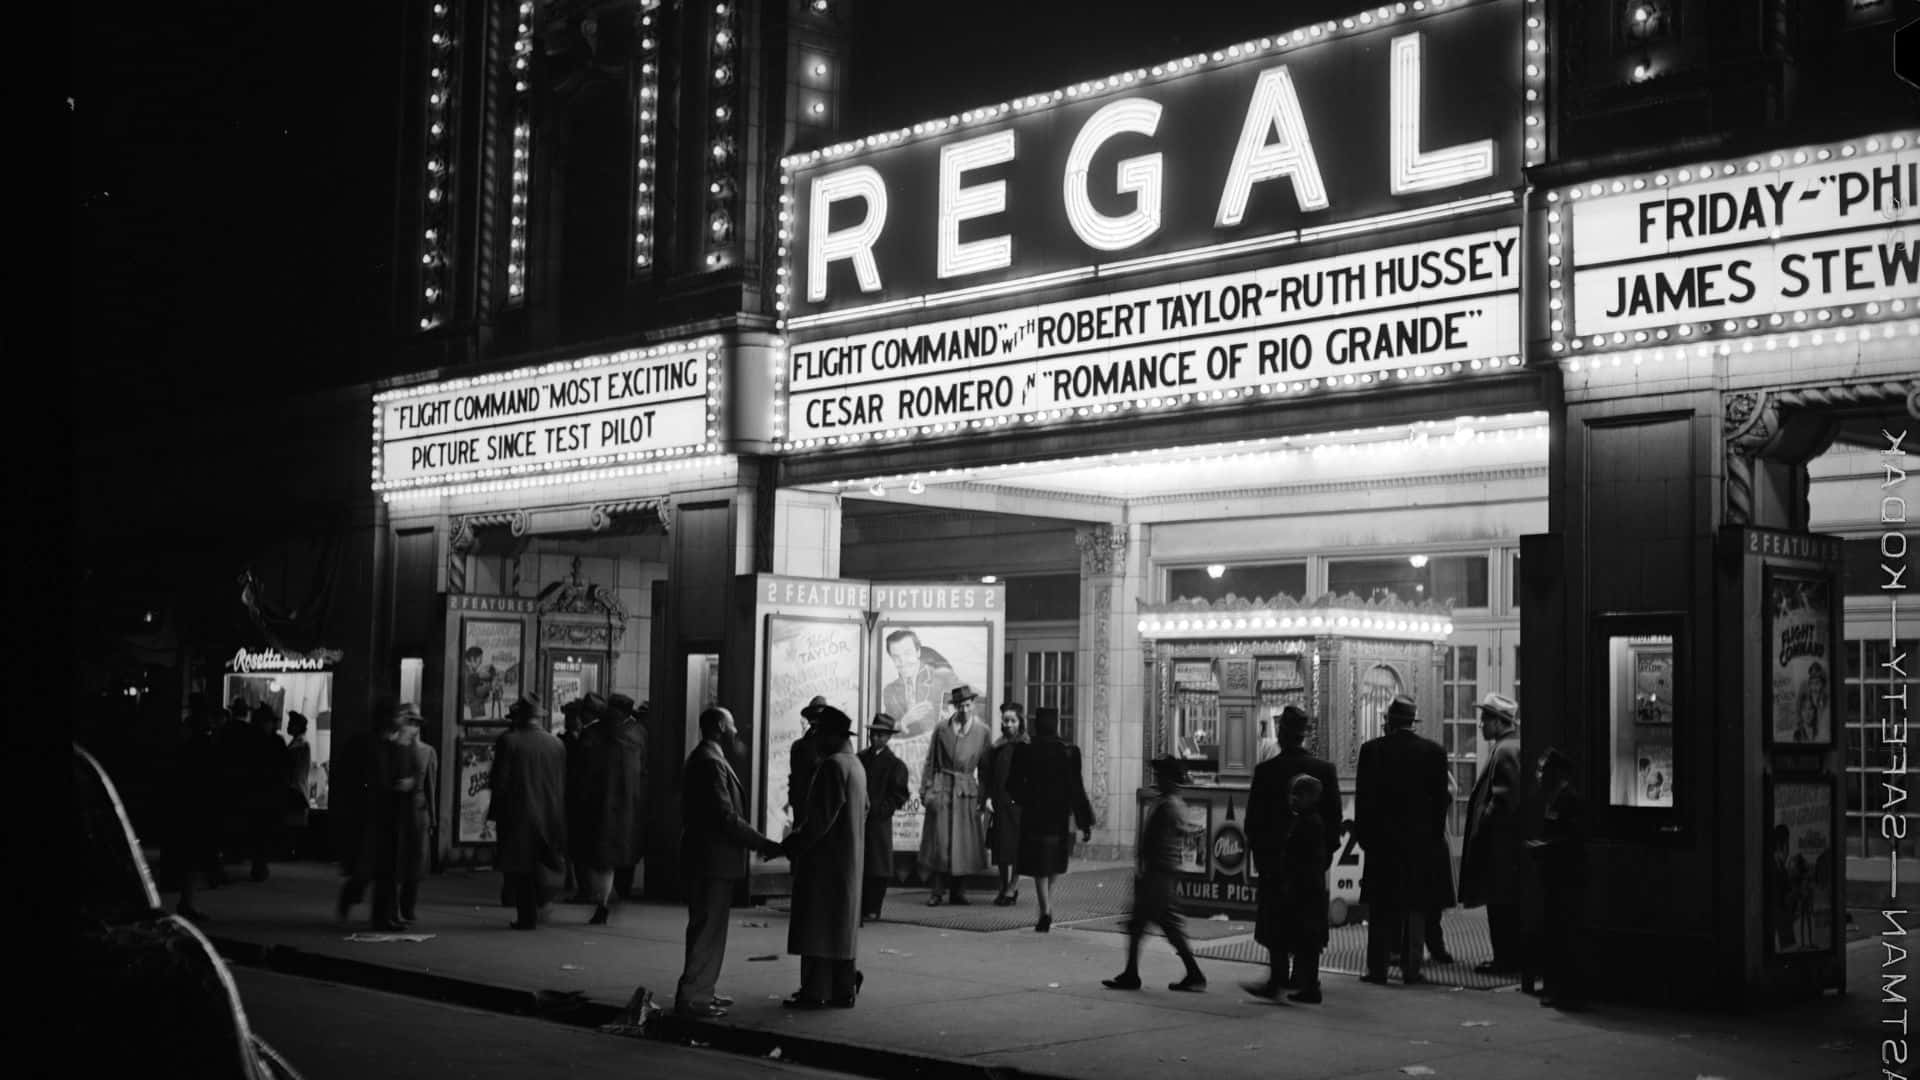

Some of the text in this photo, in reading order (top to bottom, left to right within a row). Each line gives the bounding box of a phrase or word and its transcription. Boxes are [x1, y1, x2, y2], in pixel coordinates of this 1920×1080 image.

[807, 31, 1494, 302] REGAL
[1606, 240, 1920, 318] JAMES STEW
[793, 343, 867, 382] FLIGHT
[1037, 300, 1151, 348] ROBERT
[1375, 237, 1517, 296] HUSSEY
[608, 358, 698, 400] EXCITING
[806, 394, 884, 429] CESAR
[899, 375, 1013, 420] ROMERO
[1206, 343, 1248, 382] OF
[1258, 334, 1312, 375] RIO
[412, 411, 656, 470] PICTURE SINCE TEST PILOT
[1751, 534, 1759, 552] 2
[462, 596, 534, 612] FEATURES
[768, 583, 867, 607] 2 FEATURE
[876, 589, 995, 609] PICTURES 2
[799, 641, 849, 664] TAYLOR
[1175, 880, 1219, 899] ATURE
[1338, 878, 1353, 889] on
